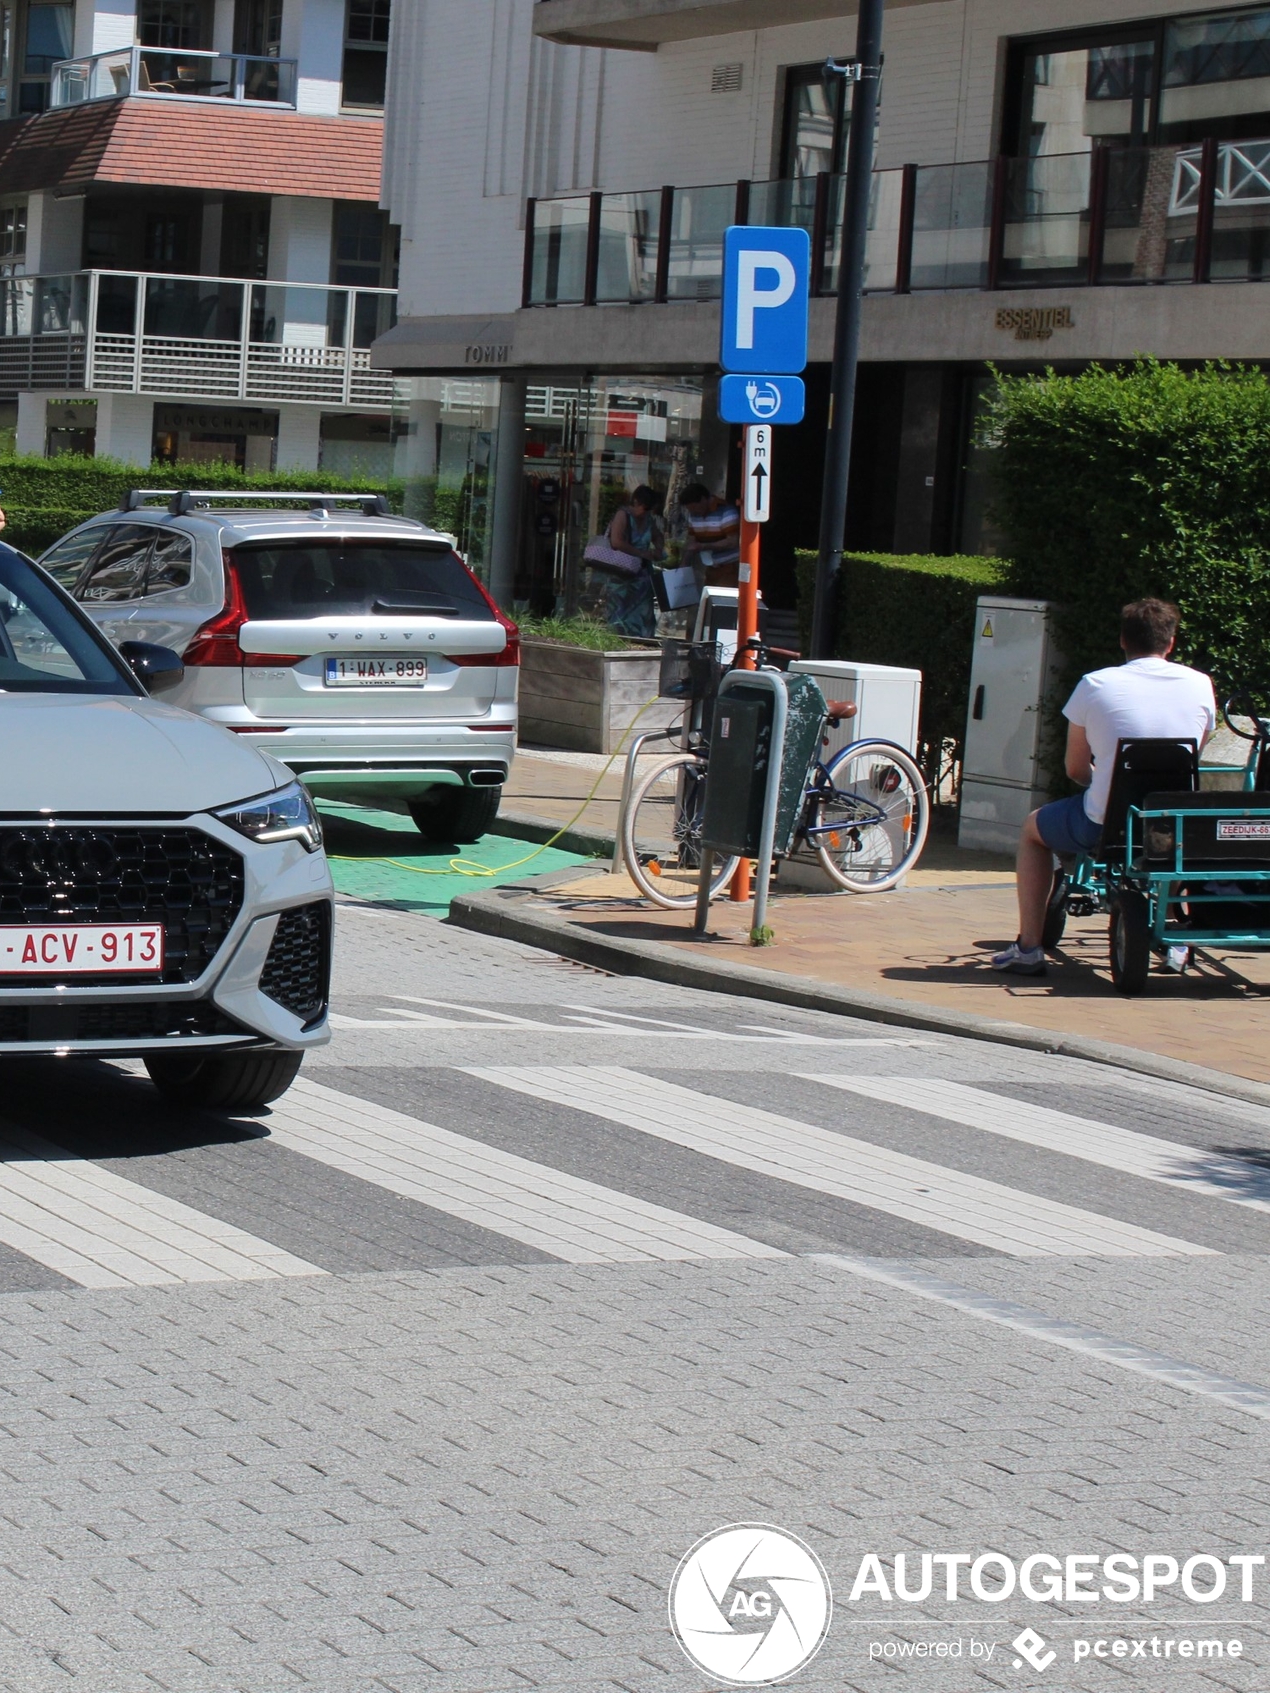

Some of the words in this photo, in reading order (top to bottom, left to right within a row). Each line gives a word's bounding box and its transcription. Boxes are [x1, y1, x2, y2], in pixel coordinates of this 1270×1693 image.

[736, 250, 796, 349] P
[995, 306, 1075, 329] ESSENTIEL
[464, 345, 513, 363] TOMM
[164, 415, 271, 429] LONGCHAMP
[756, 430, 765, 444] 6
[754, 446, 766, 457] m
[328, 631, 436, 640] VOLVO
[339, 661, 424, 677] 1-WAX-899
[1222, 826, 1270, 834] ZEEDIJK-66
